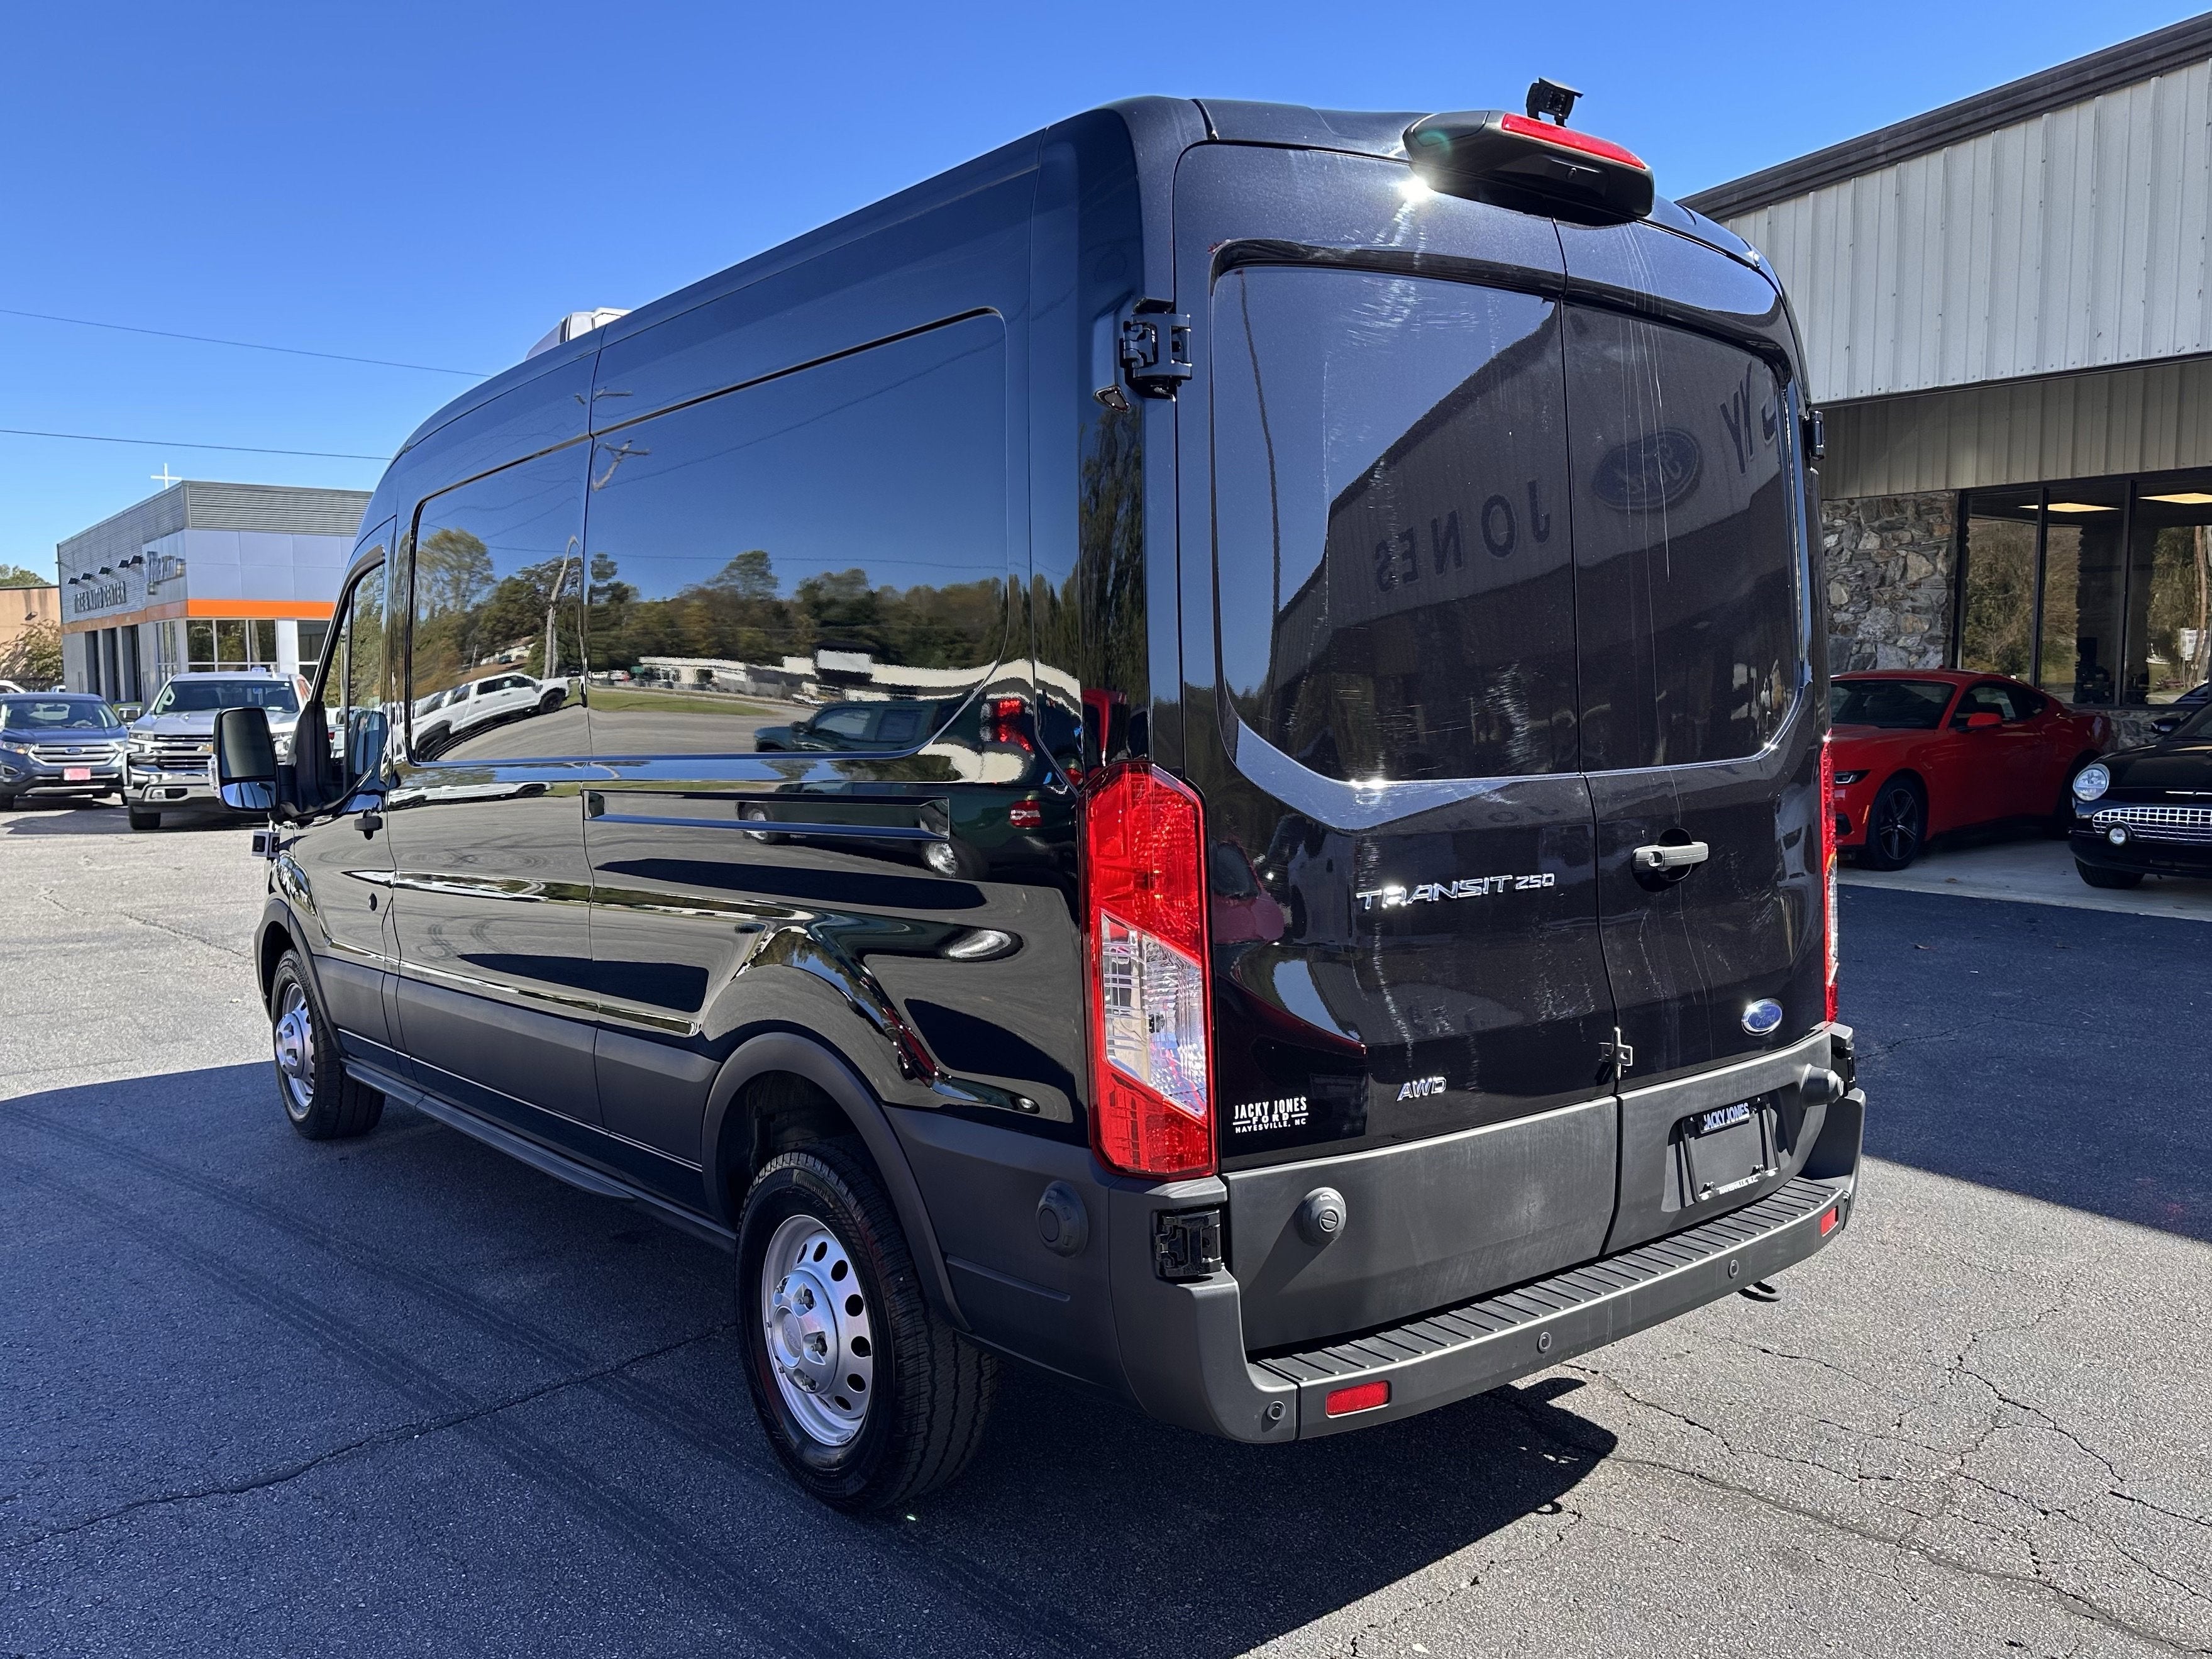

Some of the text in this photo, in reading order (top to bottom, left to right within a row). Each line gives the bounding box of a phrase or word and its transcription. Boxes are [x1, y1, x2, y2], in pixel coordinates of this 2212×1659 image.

[1356, 874, 1555, 910] TRANSIT 250
[1396, 1076, 1447, 1102] AWD
[1234, 1097, 1307, 1119] JACKY JONES
[1252, 1112, 1289, 1124] FORD
[1703, 1102, 1750, 1131] JACKY JONES
